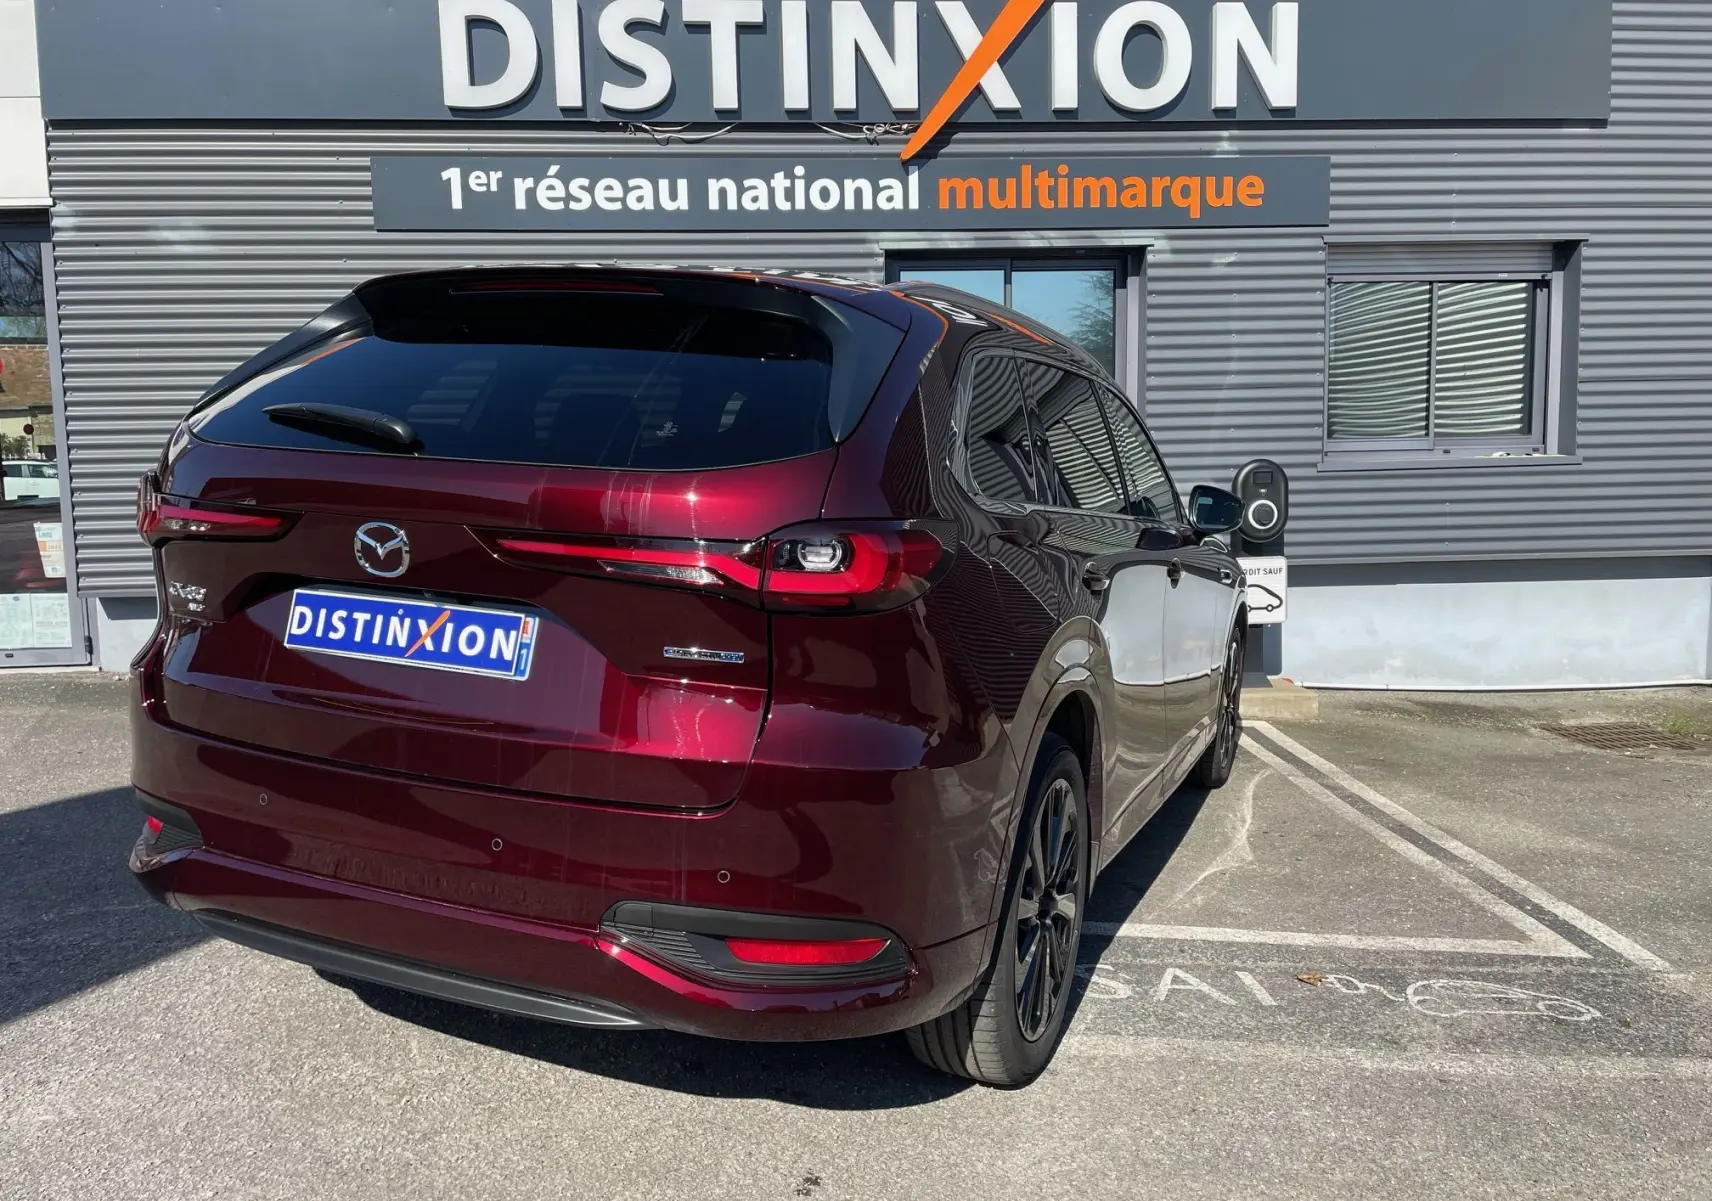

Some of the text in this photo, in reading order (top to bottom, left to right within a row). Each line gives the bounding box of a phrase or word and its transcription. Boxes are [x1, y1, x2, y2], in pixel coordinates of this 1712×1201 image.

[438, 0, 1299, 160] DISTINXION
[441, 163, 1265, 219] 1er réseau national multimarque
[1244, 567, 1283, 576] RDIT SAUF
[290, 605, 517, 661] DISTINXION
